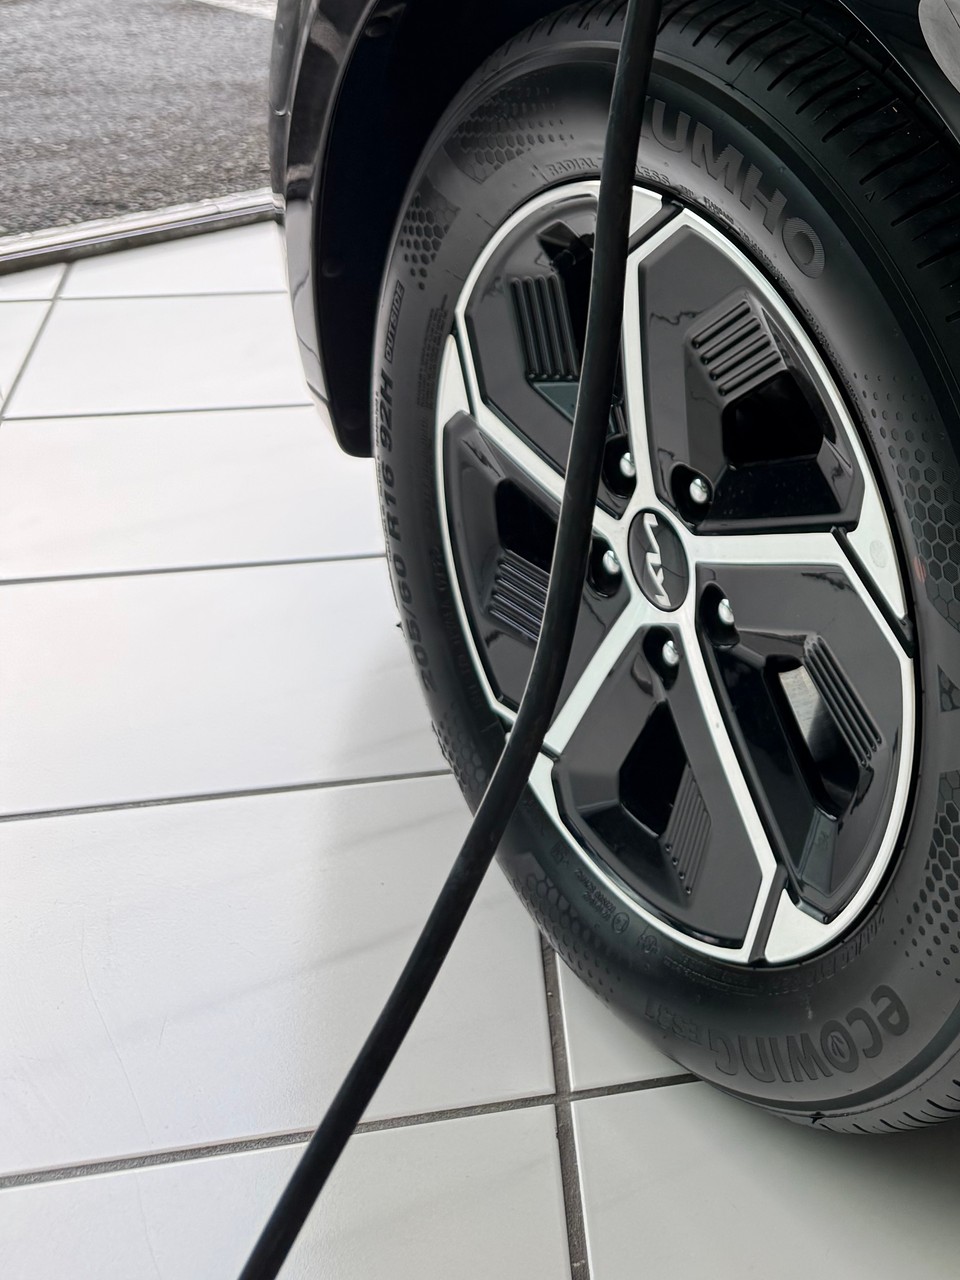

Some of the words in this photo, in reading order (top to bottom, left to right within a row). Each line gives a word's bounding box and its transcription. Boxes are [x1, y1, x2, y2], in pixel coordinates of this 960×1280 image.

[643, 95, 826, 279] UMHO
[385, 282, 404, 363] OUTSIDE
[379, 370, 395, 454] 92H
[382, 464, 402, 542] R16
[393, 553, 438, 694] 205/60
